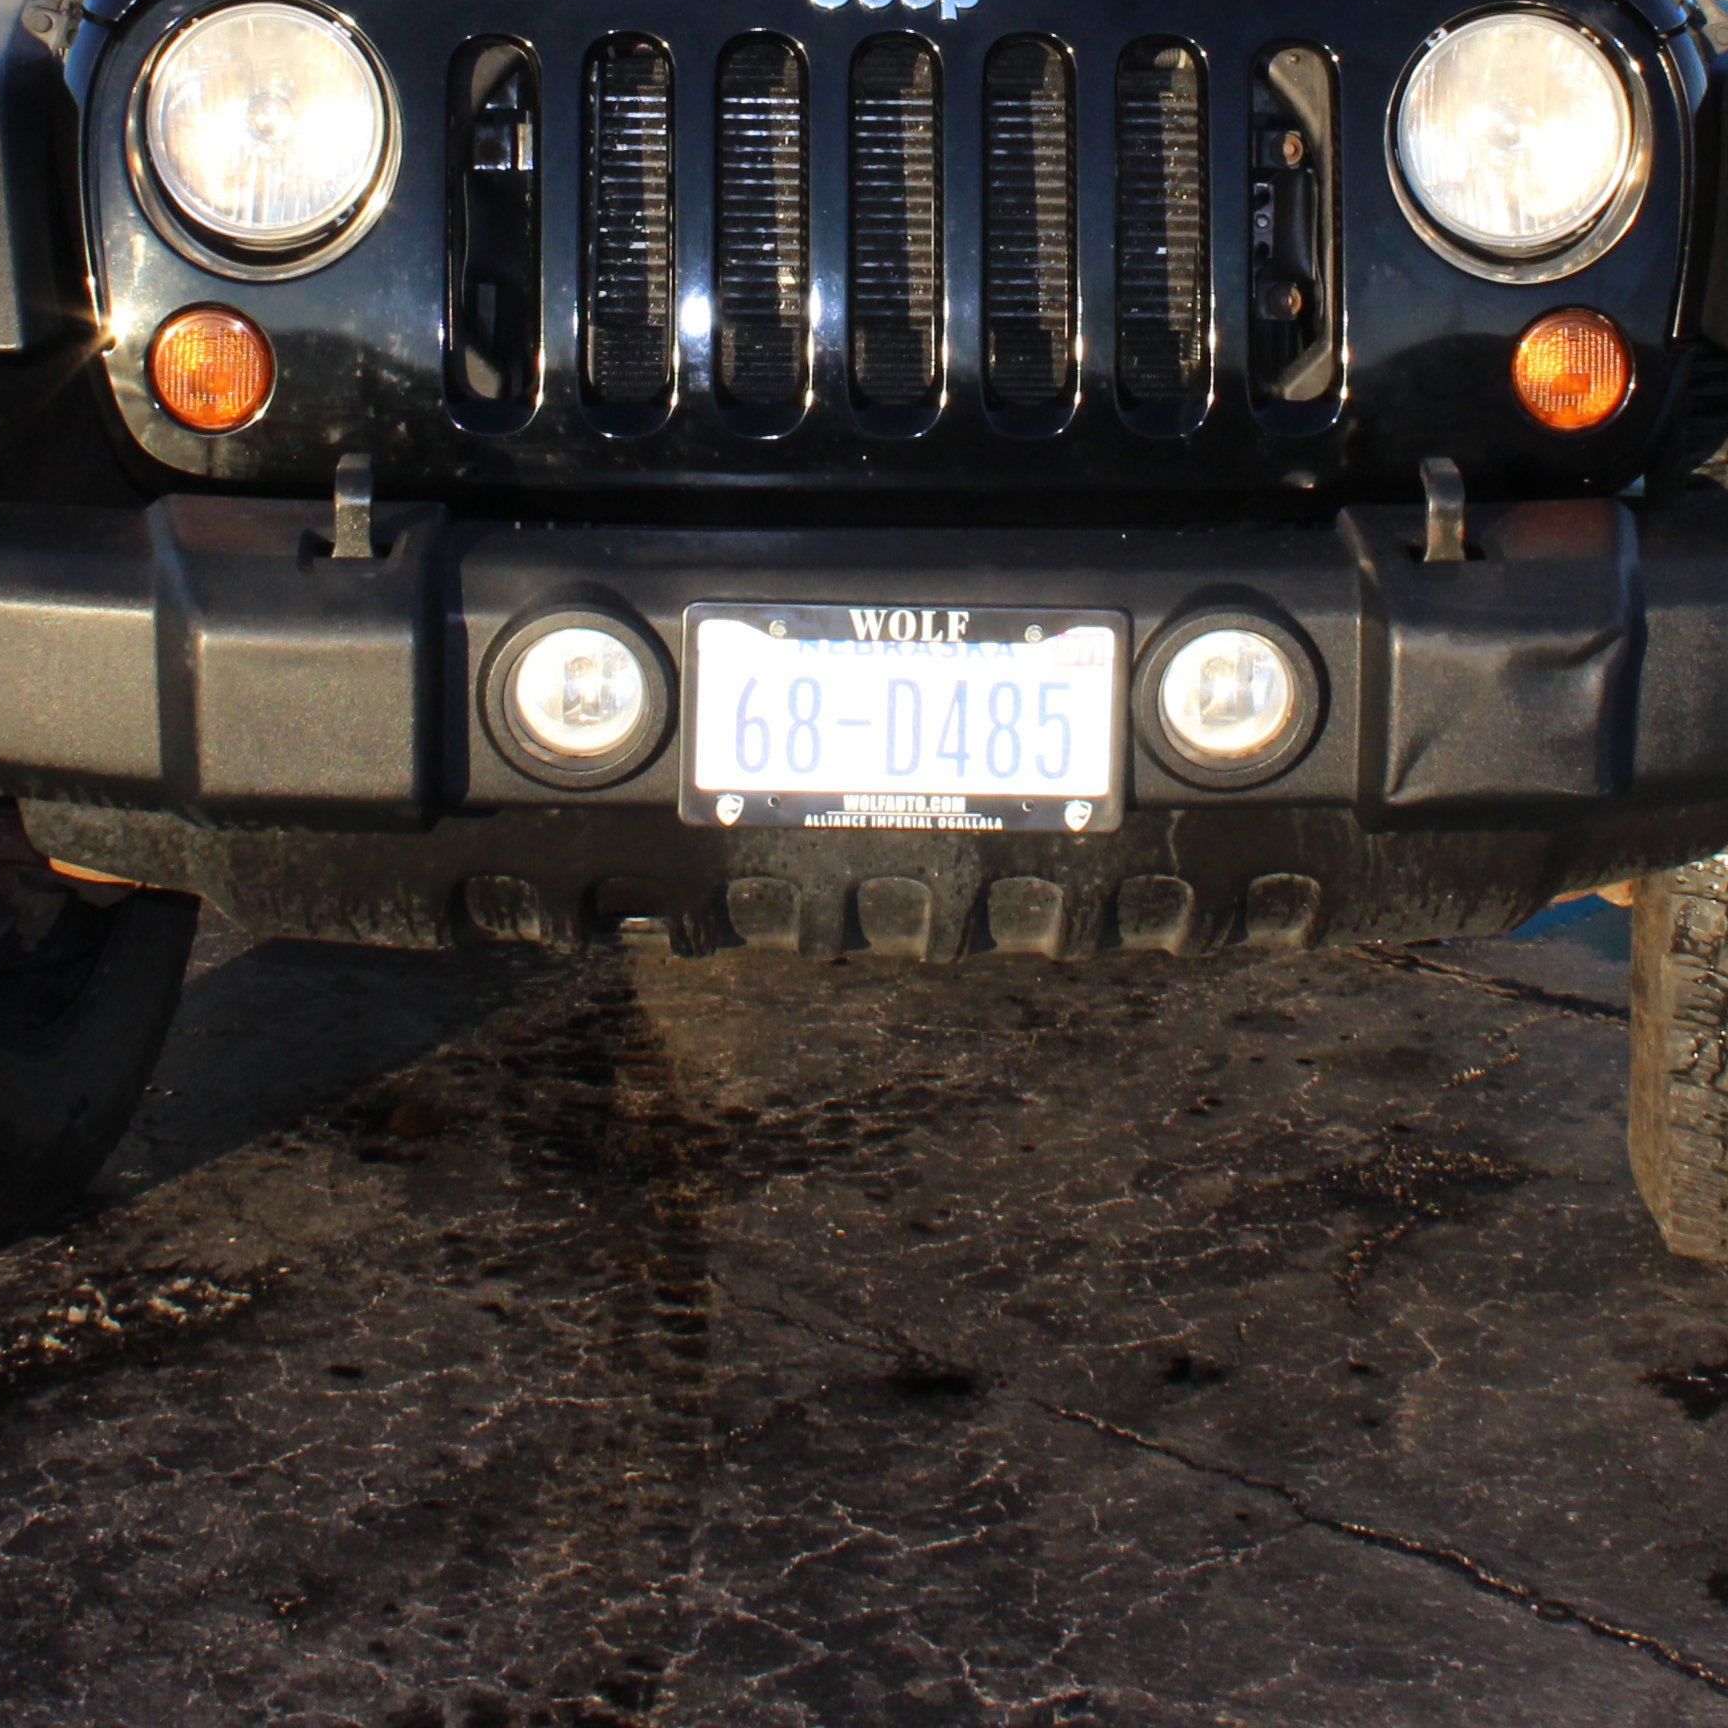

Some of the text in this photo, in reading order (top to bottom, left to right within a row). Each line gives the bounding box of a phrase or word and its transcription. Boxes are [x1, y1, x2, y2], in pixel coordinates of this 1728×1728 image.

[849, 609, 970, 643] WOLF
[735, 676, 1072, 780] 68-D485
[843, 794, 967, 813] WOLFAUTO.COM
[804, 813, 1004, 830] ALLIANCE IMPERIAL OGALLALA
